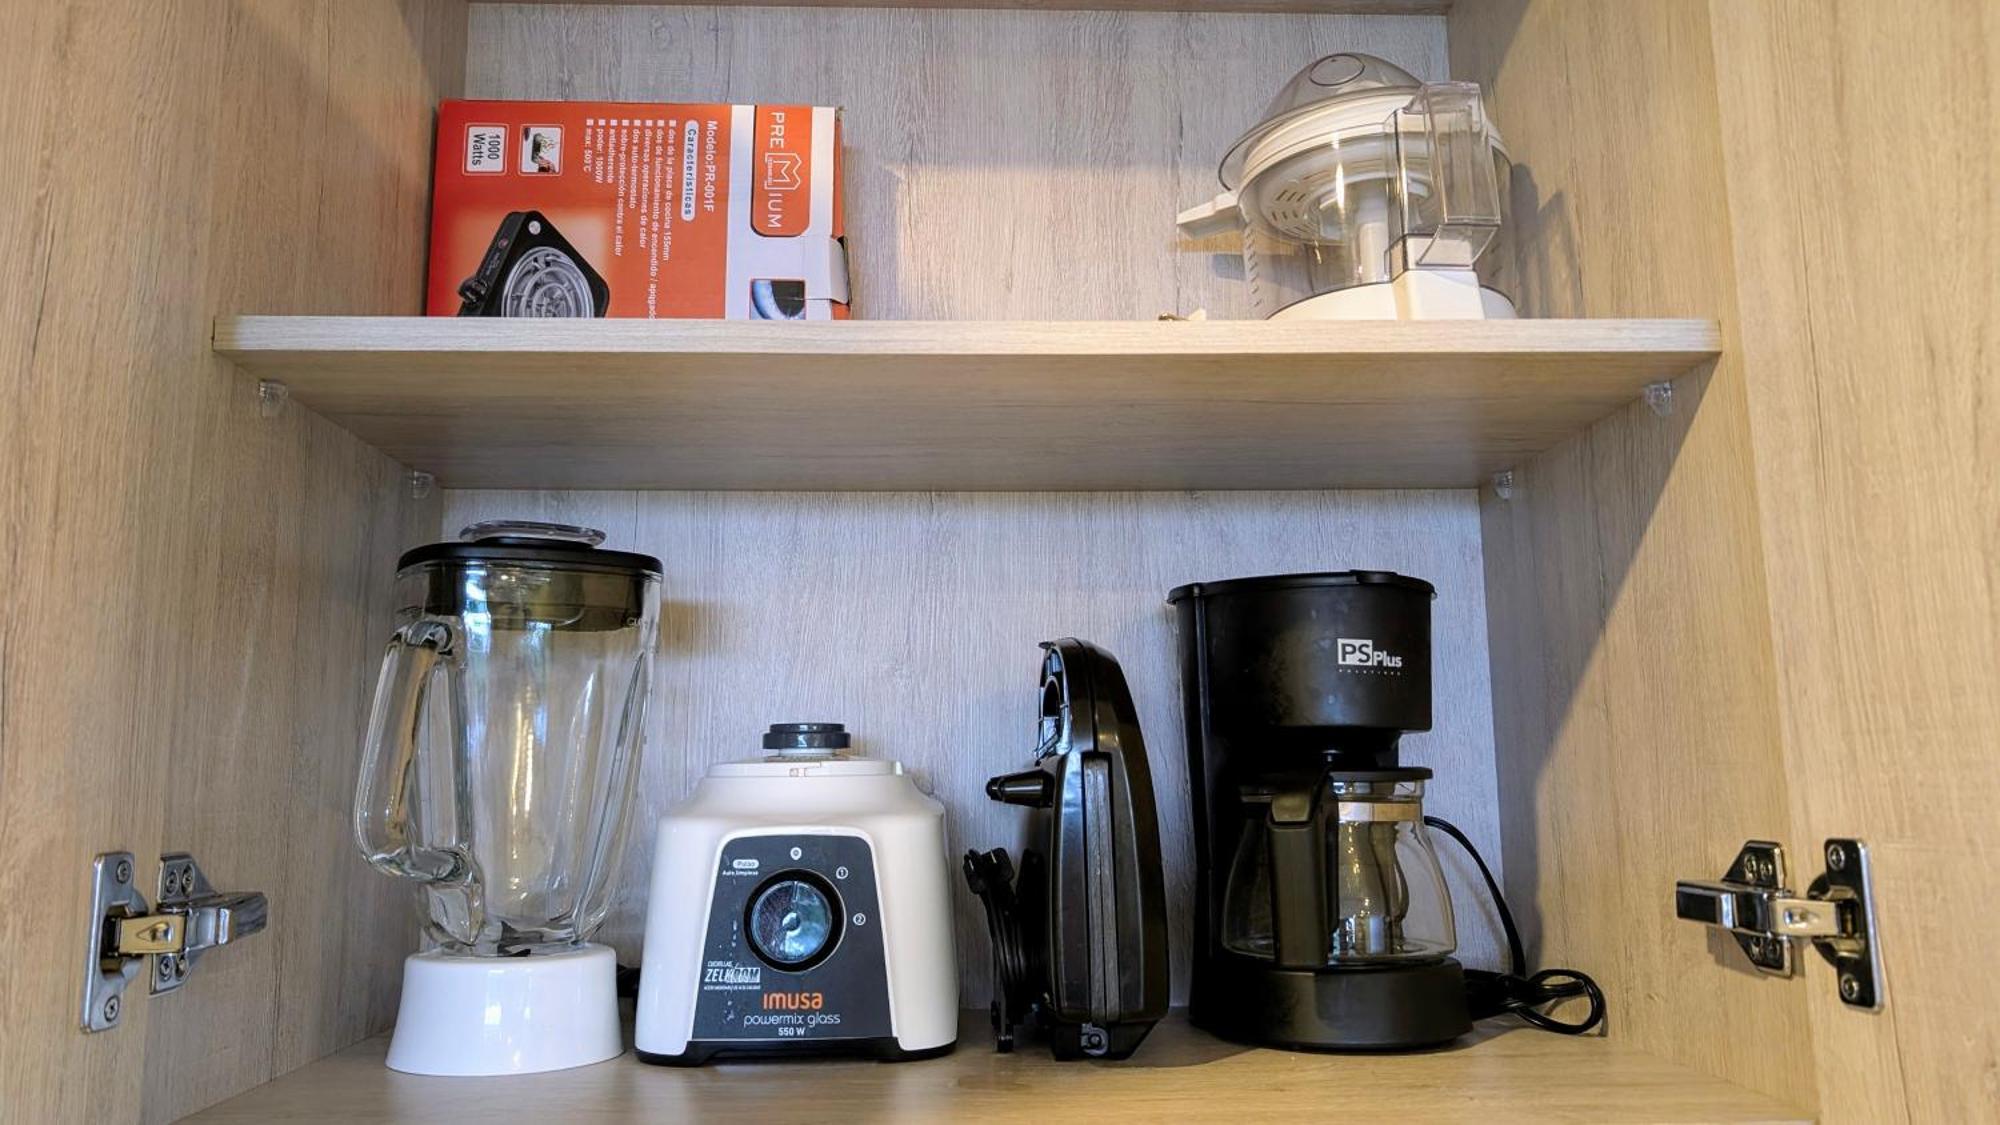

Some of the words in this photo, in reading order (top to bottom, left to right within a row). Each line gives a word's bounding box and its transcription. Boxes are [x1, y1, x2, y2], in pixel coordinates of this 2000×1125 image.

[471, 133, 486, 166] Watts
[487, 134, 500, 160] 1000
[1340, 643, 1371, 664] PS
[1372, 650, 1402, 668] Plus
[763, 991, 823, 1010] imusa
[743, 1012, 804, 1028] powermix
[807, 1012, 841, 1028] glass
[778, 1027, 794, 1036] 550
[796, 1027, 806, 1036] W
